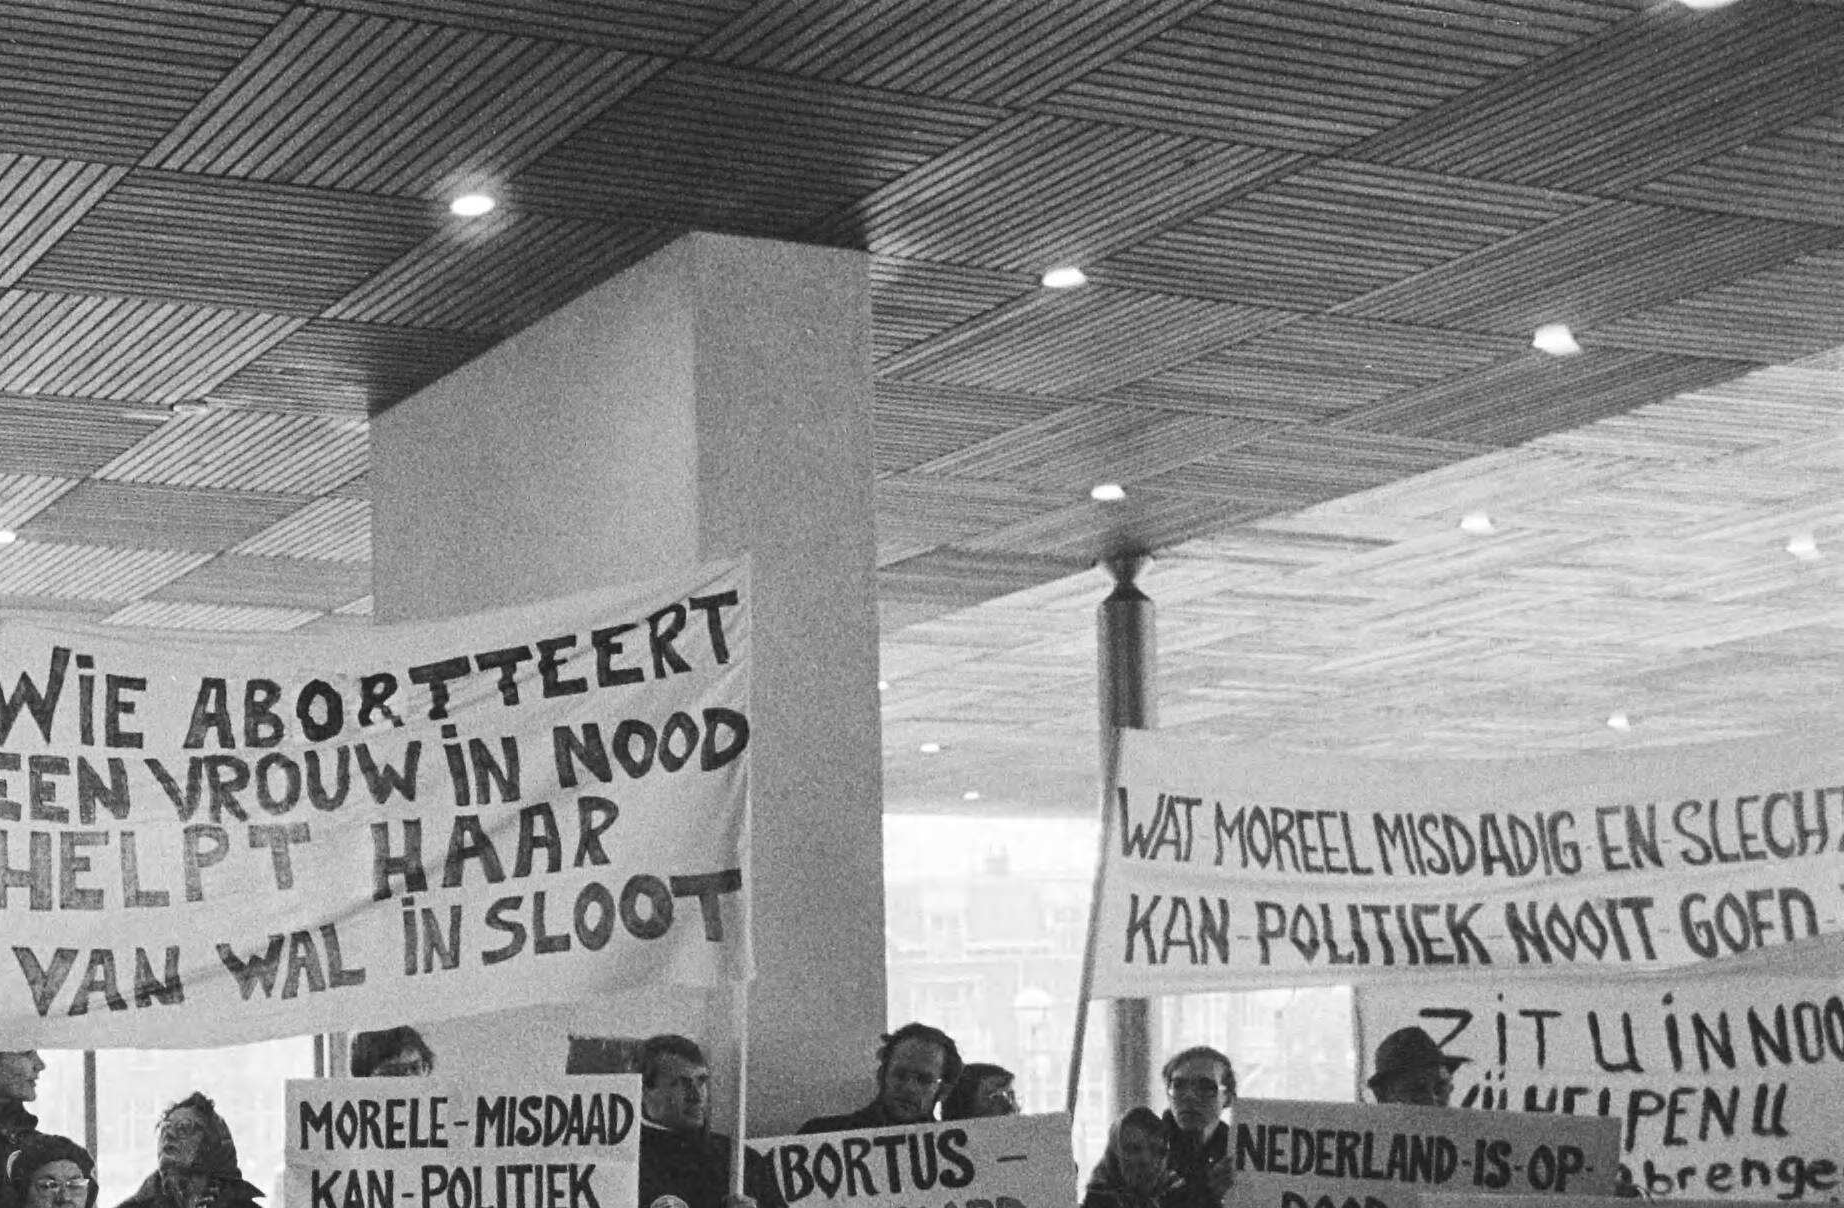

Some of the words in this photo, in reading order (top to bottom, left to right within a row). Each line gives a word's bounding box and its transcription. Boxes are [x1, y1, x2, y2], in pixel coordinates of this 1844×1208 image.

[143, 740, 422, 824] VROUW
[553, 707, 750, 788] NOOD
[370, 795, 619, 901] HAAR
[1118, 786, 1202, 863] WAT
[1214, 801, 1374, 876] MOREEL
[1373, 810, 1582, 877] MISDADIG
[1595, 803, 1664, 871] EN
[11, 944, 185, 1018] VAN
[216, 922, 366, 1001] WAL
[481, 868, 742, 966] SLOOT
[1587, 1010, 1644, 1073] U
[1752, 1083, 1789, 1138] U
[779, 1128, 976, 1202] BORTUS
